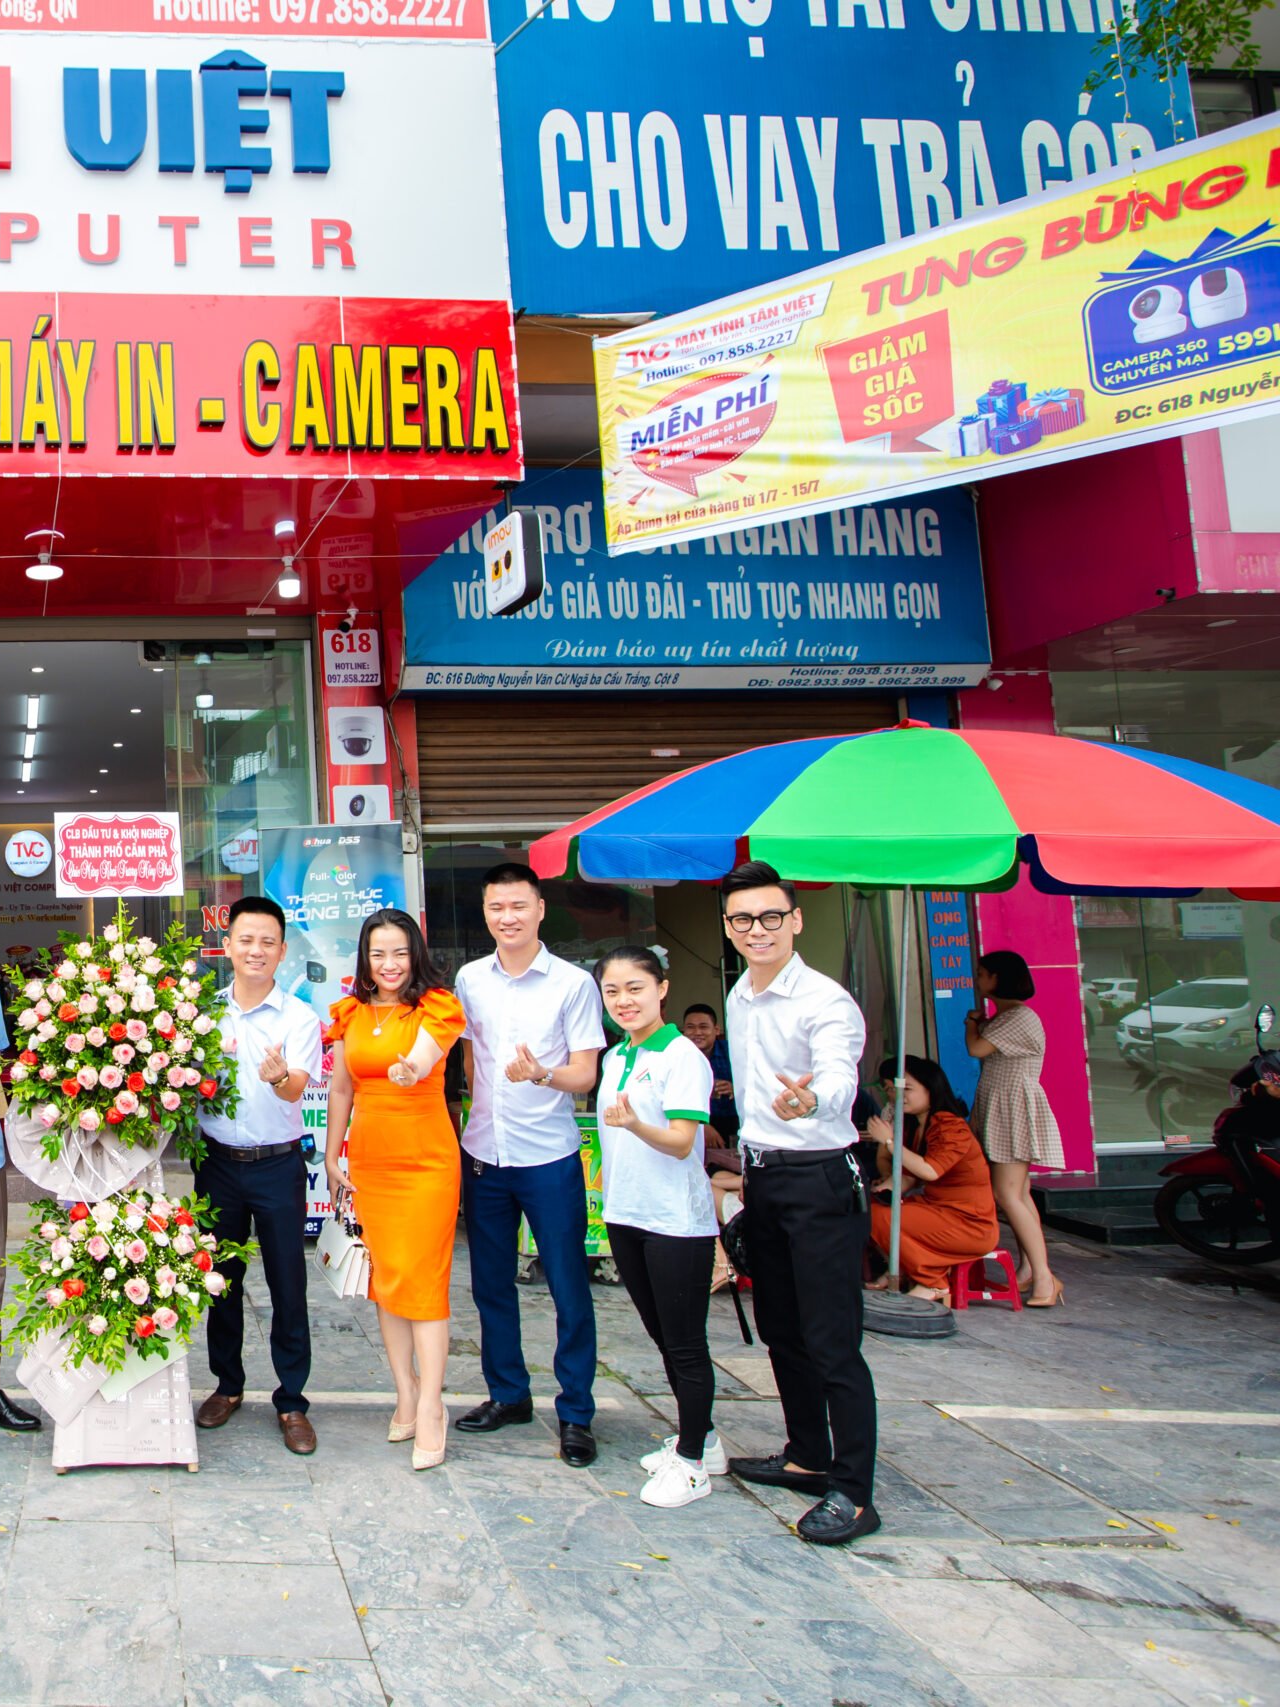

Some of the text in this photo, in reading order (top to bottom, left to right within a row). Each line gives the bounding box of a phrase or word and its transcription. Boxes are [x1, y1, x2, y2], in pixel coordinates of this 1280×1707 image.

[538, 60, 1000, 252] CHO VAY TRẢ
[861, 165, 1249, 315] TƯNG BỪNG
[675, 329, 706, 348] MÁY
[711, 317, 745, 337] TÍNH
[749, 306, 779, 325] TÂN
[783, 293, 816, 313] VIỆT
[645, 330, 794, 383] Hotline: 097.858.2227
[848, 331, 927, 374] GIẢM
[1102, 339, 1207, 373] CAMERA 360
[865, 363, 917, 397] GIÁ
[1103, 352, 1209, 386] KHUYẾN MẠI
[115, 341, 177, 452] IN
[242, 339, 510, 455] CAMERA
[863, 391, 924, 427] SỐC
[1115, 394, 1193, 423] ĐC: 618
[630, 374, 770, 451] MIỄN PHÍ
[759, 489, 778, 505] 1/7
[792, 480, 820, 497] 15/7
[561, 566, 941, 628] GIÁ ƯU ĐÃI THỦ TỤC NHANH GỌN
[331, 633, 372, 654] 618
[740, 639, 788, 658] chất
[796, 639, 859, 662] lượng
[327, 673, 379, 684] 097.858.2227
[335, 662, 370, 670] HOTLINE:
[790, 667, 843, 676] Hotline:
[425, 670, 679, 688] ĐC: 616 Đường Nguyễn Văn Ngã ba Cột 8
[748, 676, 966, 688] DĐ: 0982.933.999 0962.283.999
[66, 829, 80, 839] CLB
[113, 829, 119, 839] &
[338, 836, 360, 844] DSS
[13, 842, 44, 858] TVC
[69, 843, 101, 858] THÀNH
[104, 841, 122, 857] PHỐ
[941, 955, 962, 968] TÂY
[935, 976, 974, 989] NGUYÊN
